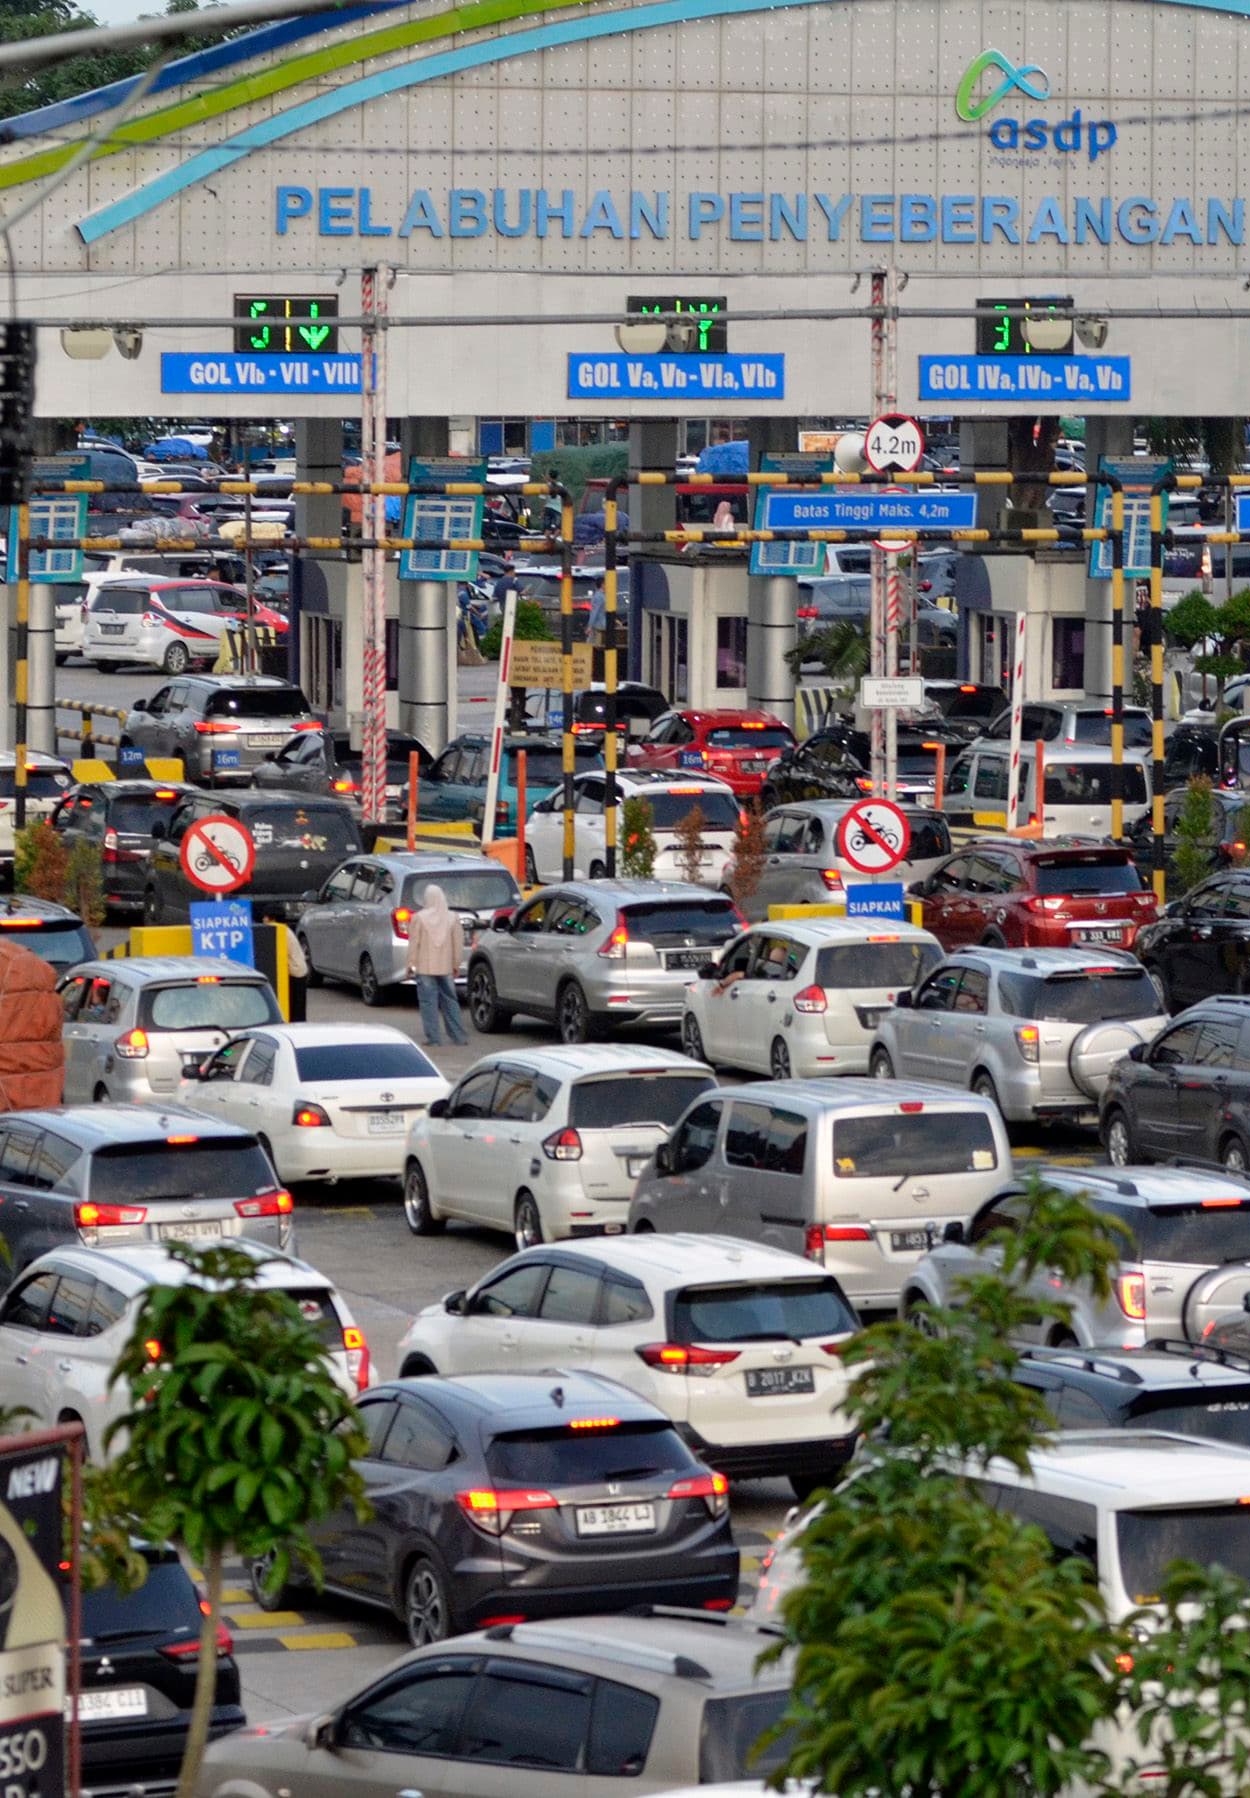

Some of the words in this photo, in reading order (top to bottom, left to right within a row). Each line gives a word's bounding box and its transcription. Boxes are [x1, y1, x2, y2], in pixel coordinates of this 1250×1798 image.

[990, 108, 1118, 163] asdp
[275, 185, 669, 240] PELABUHAN
[689, 191, 1246, 245] PENYEBERANGAN
[189, 362, 232, 385] GOL
[280, 362, 308, 385] VII
[323, 362, 359, 385] VIII
[578, 362, 621, 388] GOL
[929, 364, 971, 390] GOL
[871, 435, 916, 455] 4.2m
[794, 504, 830, 519] Batas
[834, 502, 874, 521] Tinggi
[880, 503, 914, 518] Maks.
[919, 503, 950, 520] 4,2m
[122, 751, 142, 761] 12m
[216, 754, 238, 764] 16m
[849, 900, 902, 914] SIAPKAN
[193, 916, 249, 930] SIAPKAN
[201, 930, 244, 950] KTP
[8, 1457, 60, 1500] NEW
[5, 1666, 55, 1698] SUPER
